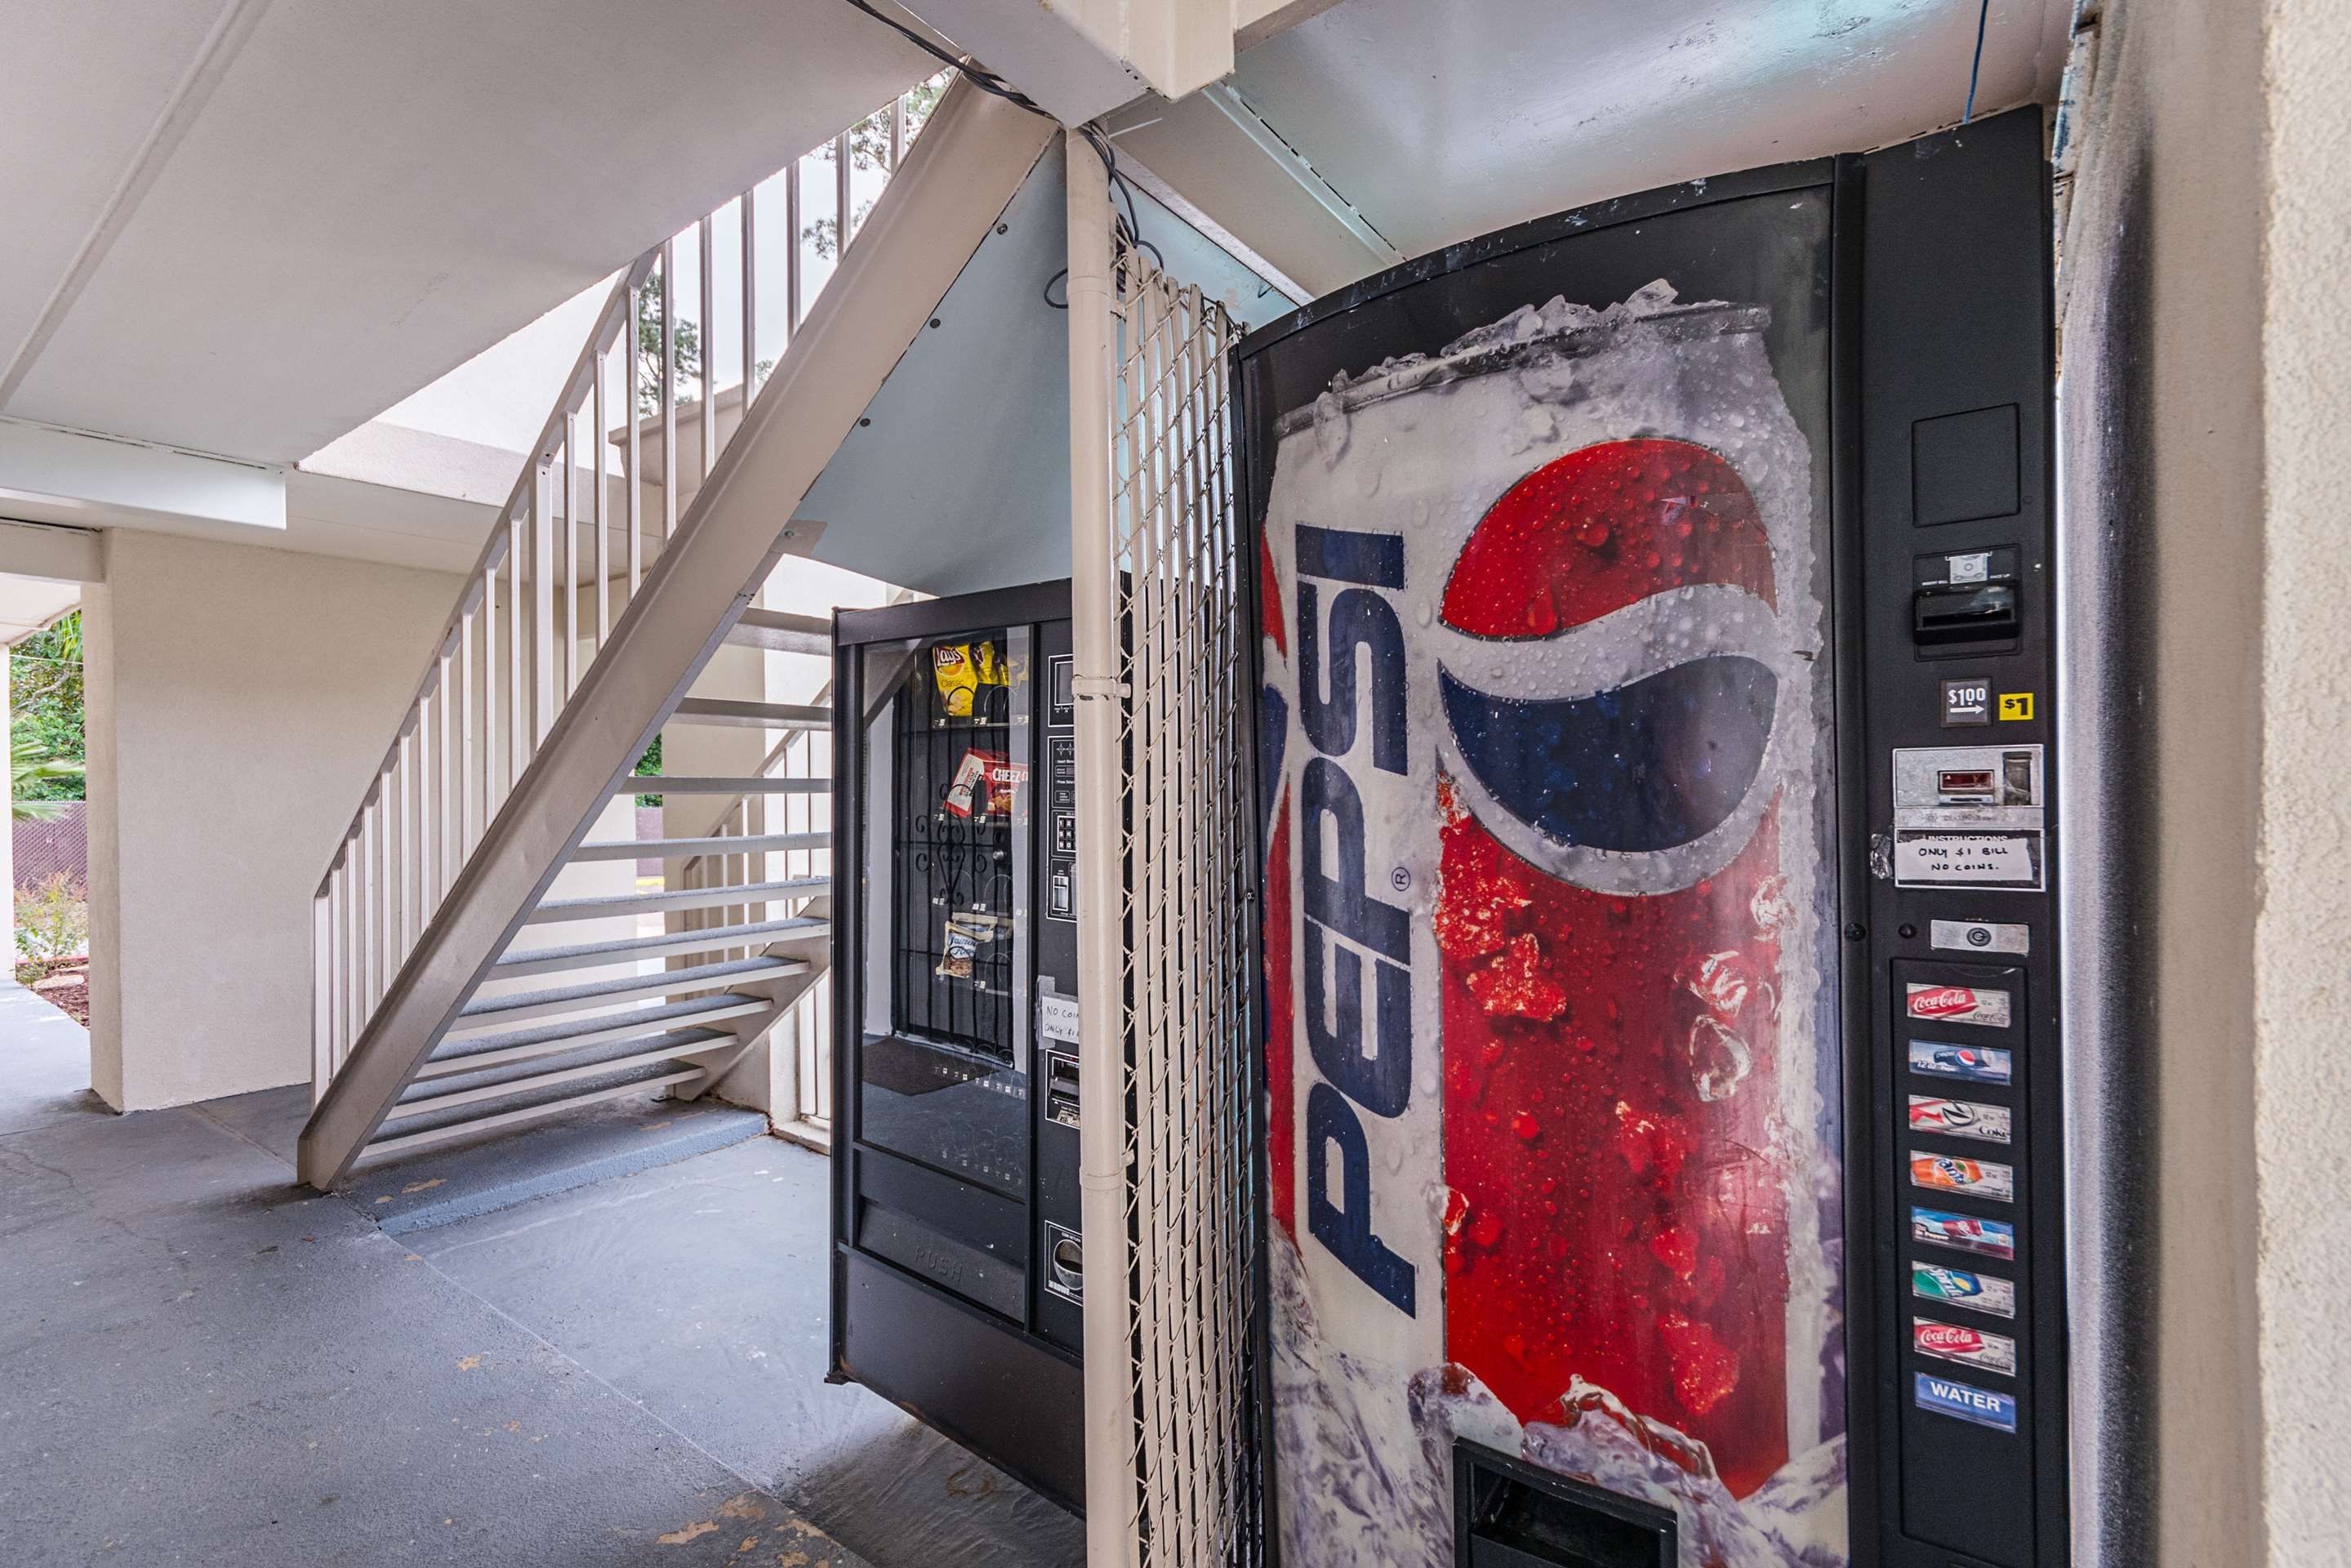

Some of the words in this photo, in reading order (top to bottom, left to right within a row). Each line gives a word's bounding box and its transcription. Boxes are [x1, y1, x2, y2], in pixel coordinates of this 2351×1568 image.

[2005, 697, 2028, 716] $1
[1918, 848, 1948, 858] ONLY
[1296, 523, 1416, 1320] PEPSI
[1046, 1005, 1058, 1016] NO
[1045, 1022, 1062, 1036] ONLY
[1930, 1381, 2001, 1413] WATER
